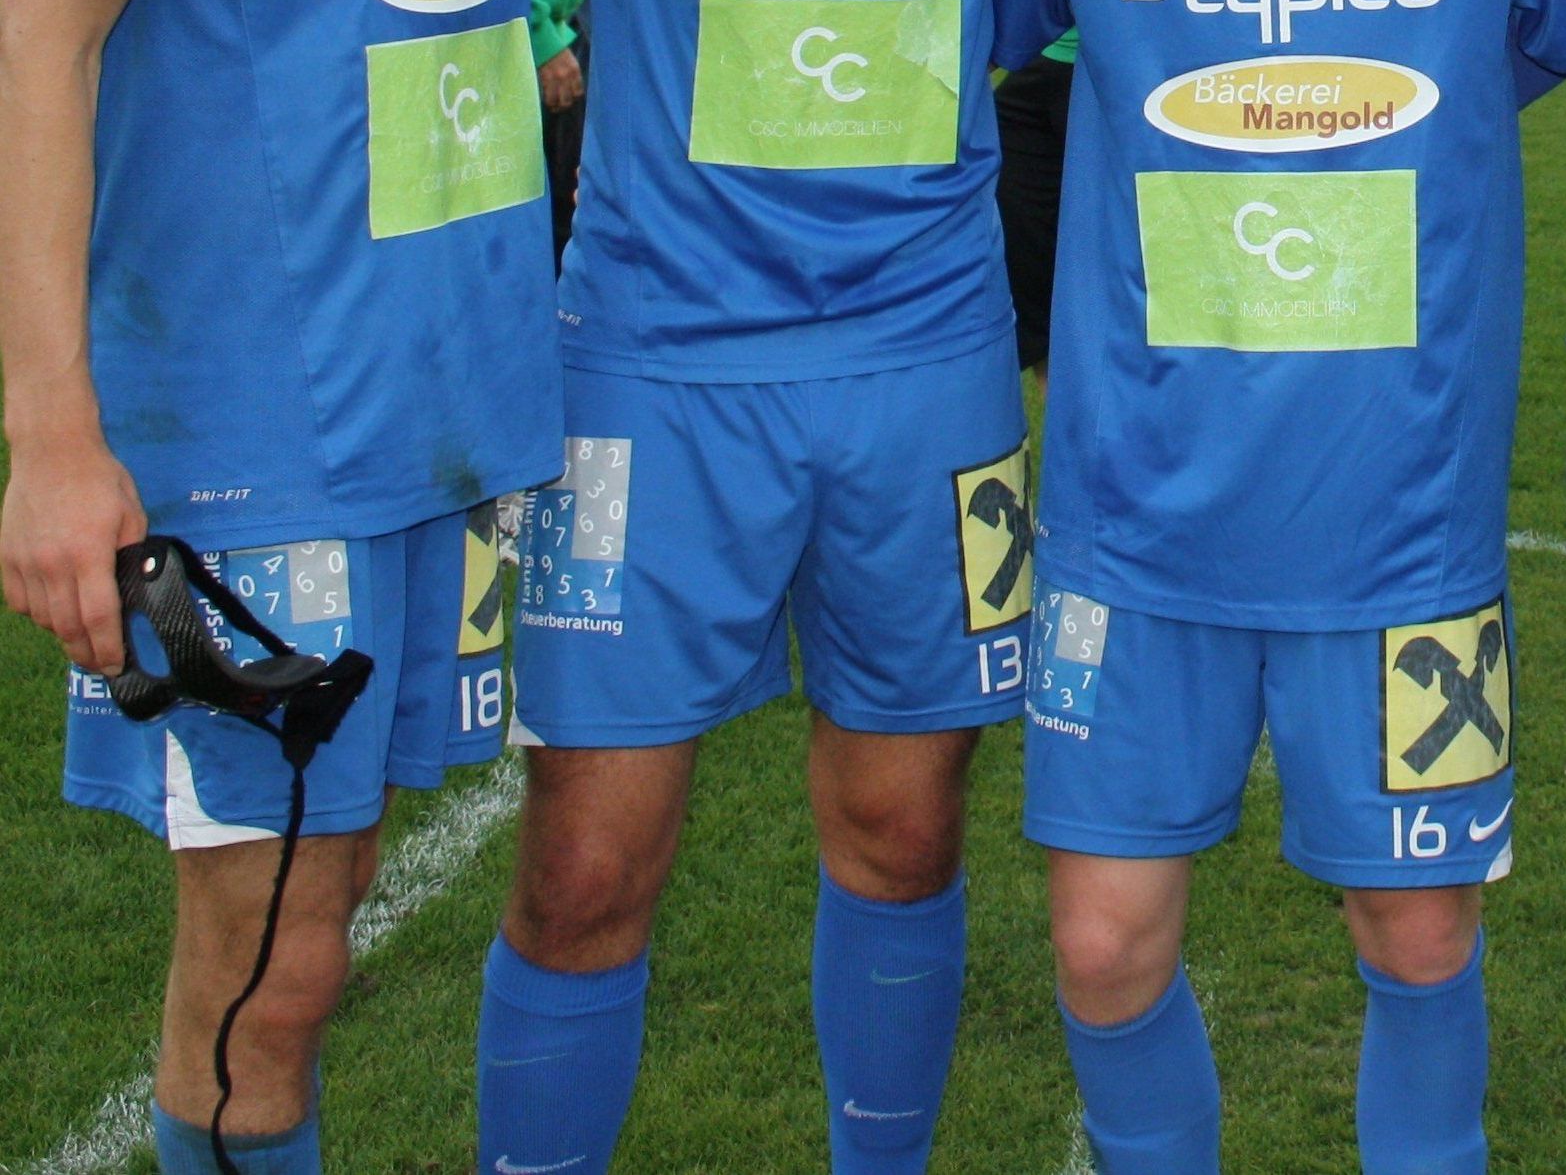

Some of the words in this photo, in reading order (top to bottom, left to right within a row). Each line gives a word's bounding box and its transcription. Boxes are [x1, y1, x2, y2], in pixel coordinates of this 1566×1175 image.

[1194, 73, 1343, 105] Bäckerei
[1243, 101, 1394, 138] Mangold
[520, 609, 624, 636] Steuerberatung
[979, 635, 1022, 694] 13
[461, 668, 502, 732] 18
[1393, 805, 1446, 858] 16
